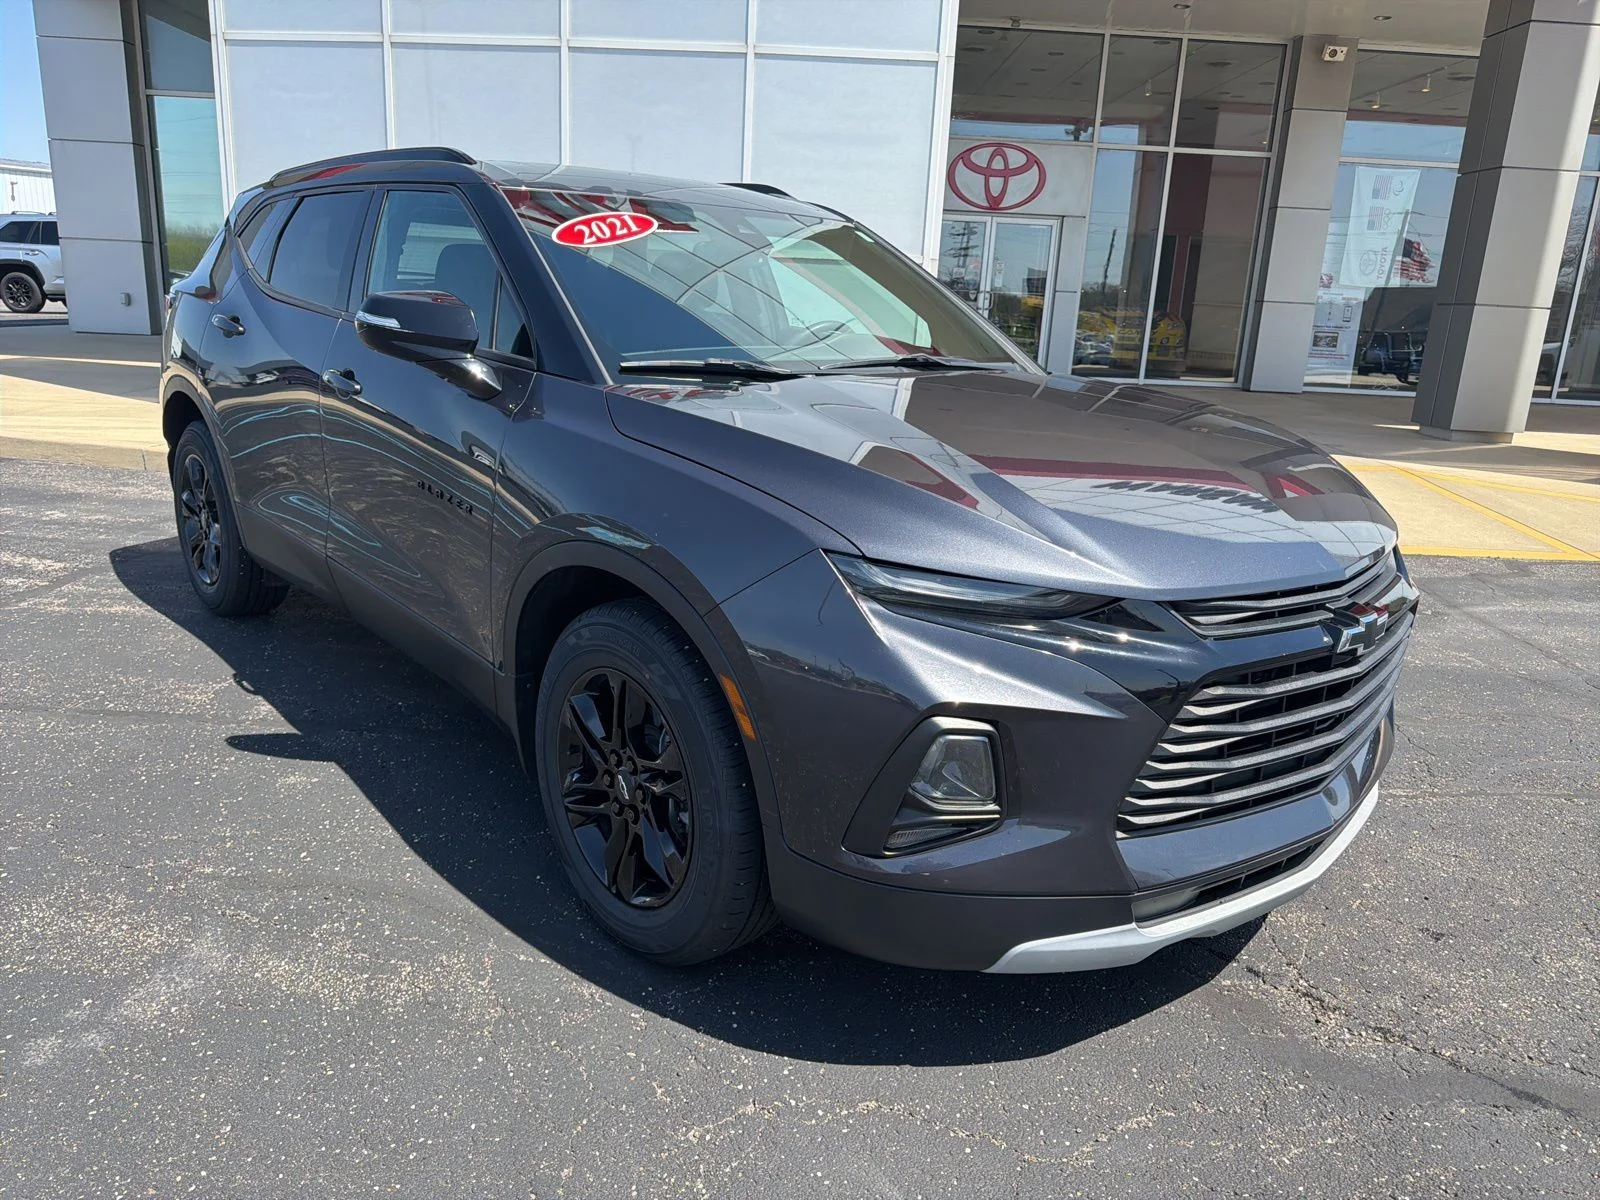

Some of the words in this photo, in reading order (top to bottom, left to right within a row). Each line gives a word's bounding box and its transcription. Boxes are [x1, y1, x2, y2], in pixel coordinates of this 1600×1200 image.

[574, 214, 642, 245] 2021
[1376, 246, 1389, 280] TOYOTA
[417, 479, 474, 515] BLAZER
